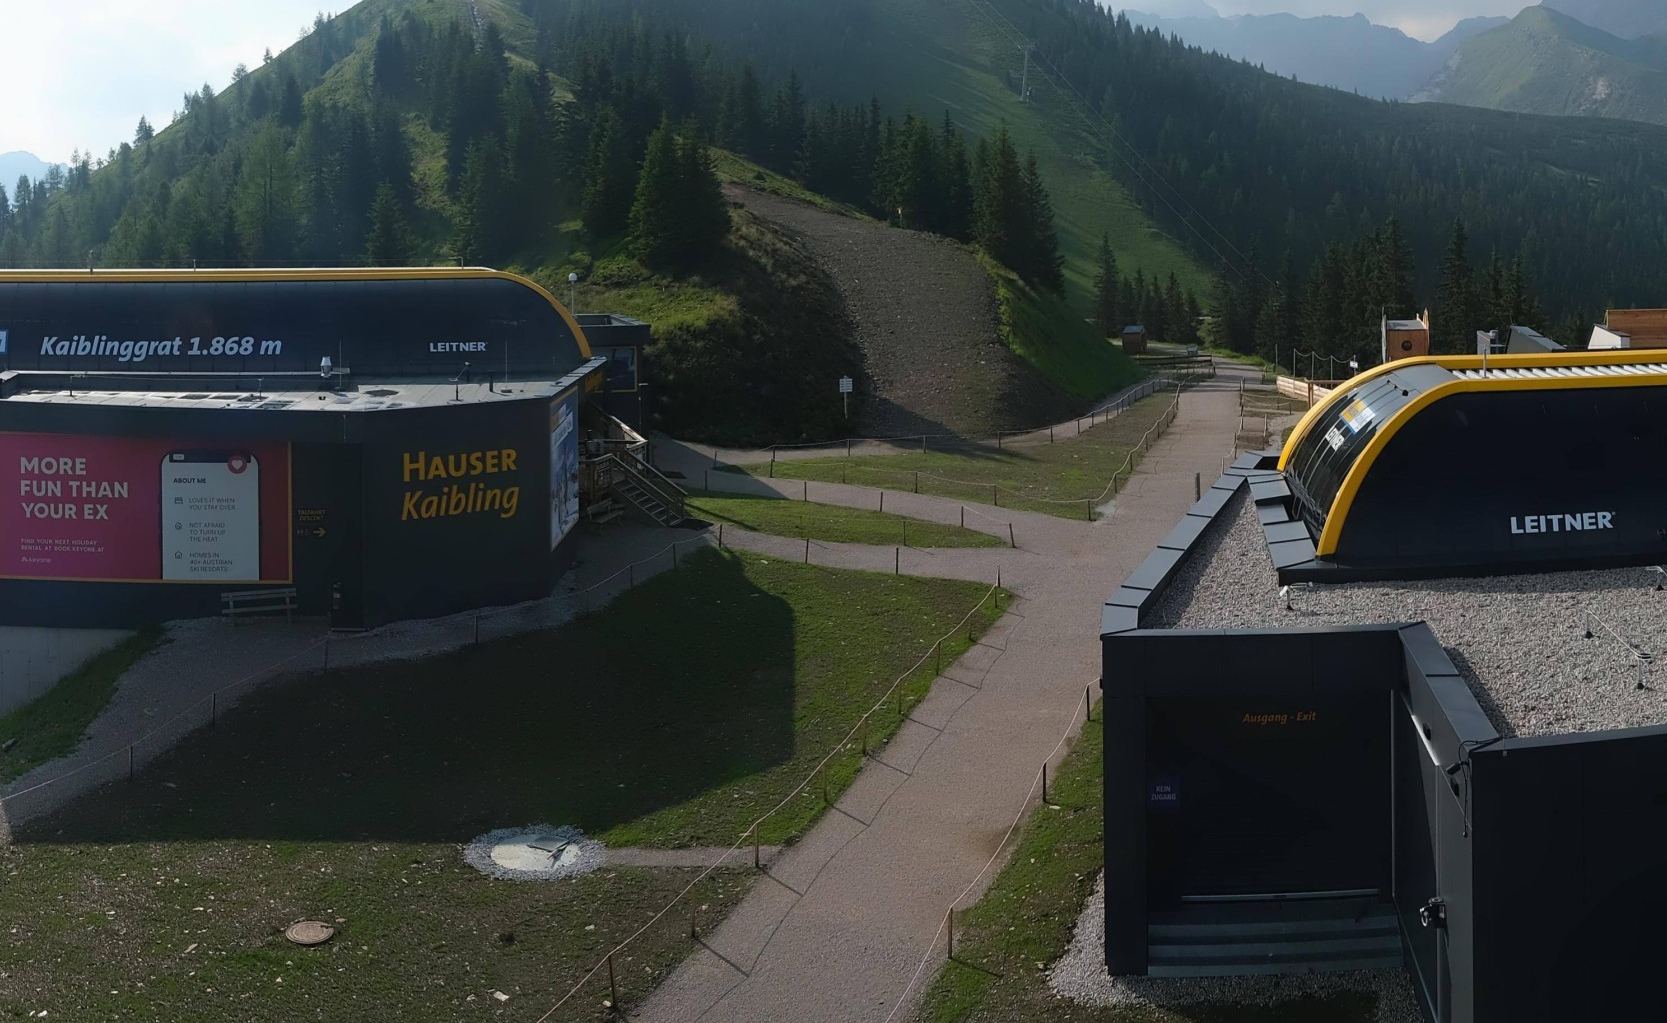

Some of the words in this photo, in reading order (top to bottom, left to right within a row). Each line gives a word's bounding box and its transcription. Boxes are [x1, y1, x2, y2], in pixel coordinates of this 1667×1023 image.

[40, 335, 182, 362] Kaiblinggrat
[187, 336, 254, 356] 1.868
[259, 339, 282, 355] m
[429, 341, 487, 352] LEITNER
[20, 456, 87, 475] MORE
[402, 448, 518, 482] HAUSER
[20, 480, 62, 497] FUN
[68, 481, 129, 498] THAN
[401, 482, 520, 521] Kaibling
[21, 502, 77, 519] YOUR
[83, 504, 108, 520] EX
[1510, 511, 1614, 534] LEITNER
[1242, 713, 1288, 725] Ausgang
[1296, 711, 1317, 721] Exit
[1156, 785, 1171, 793] KEIN
